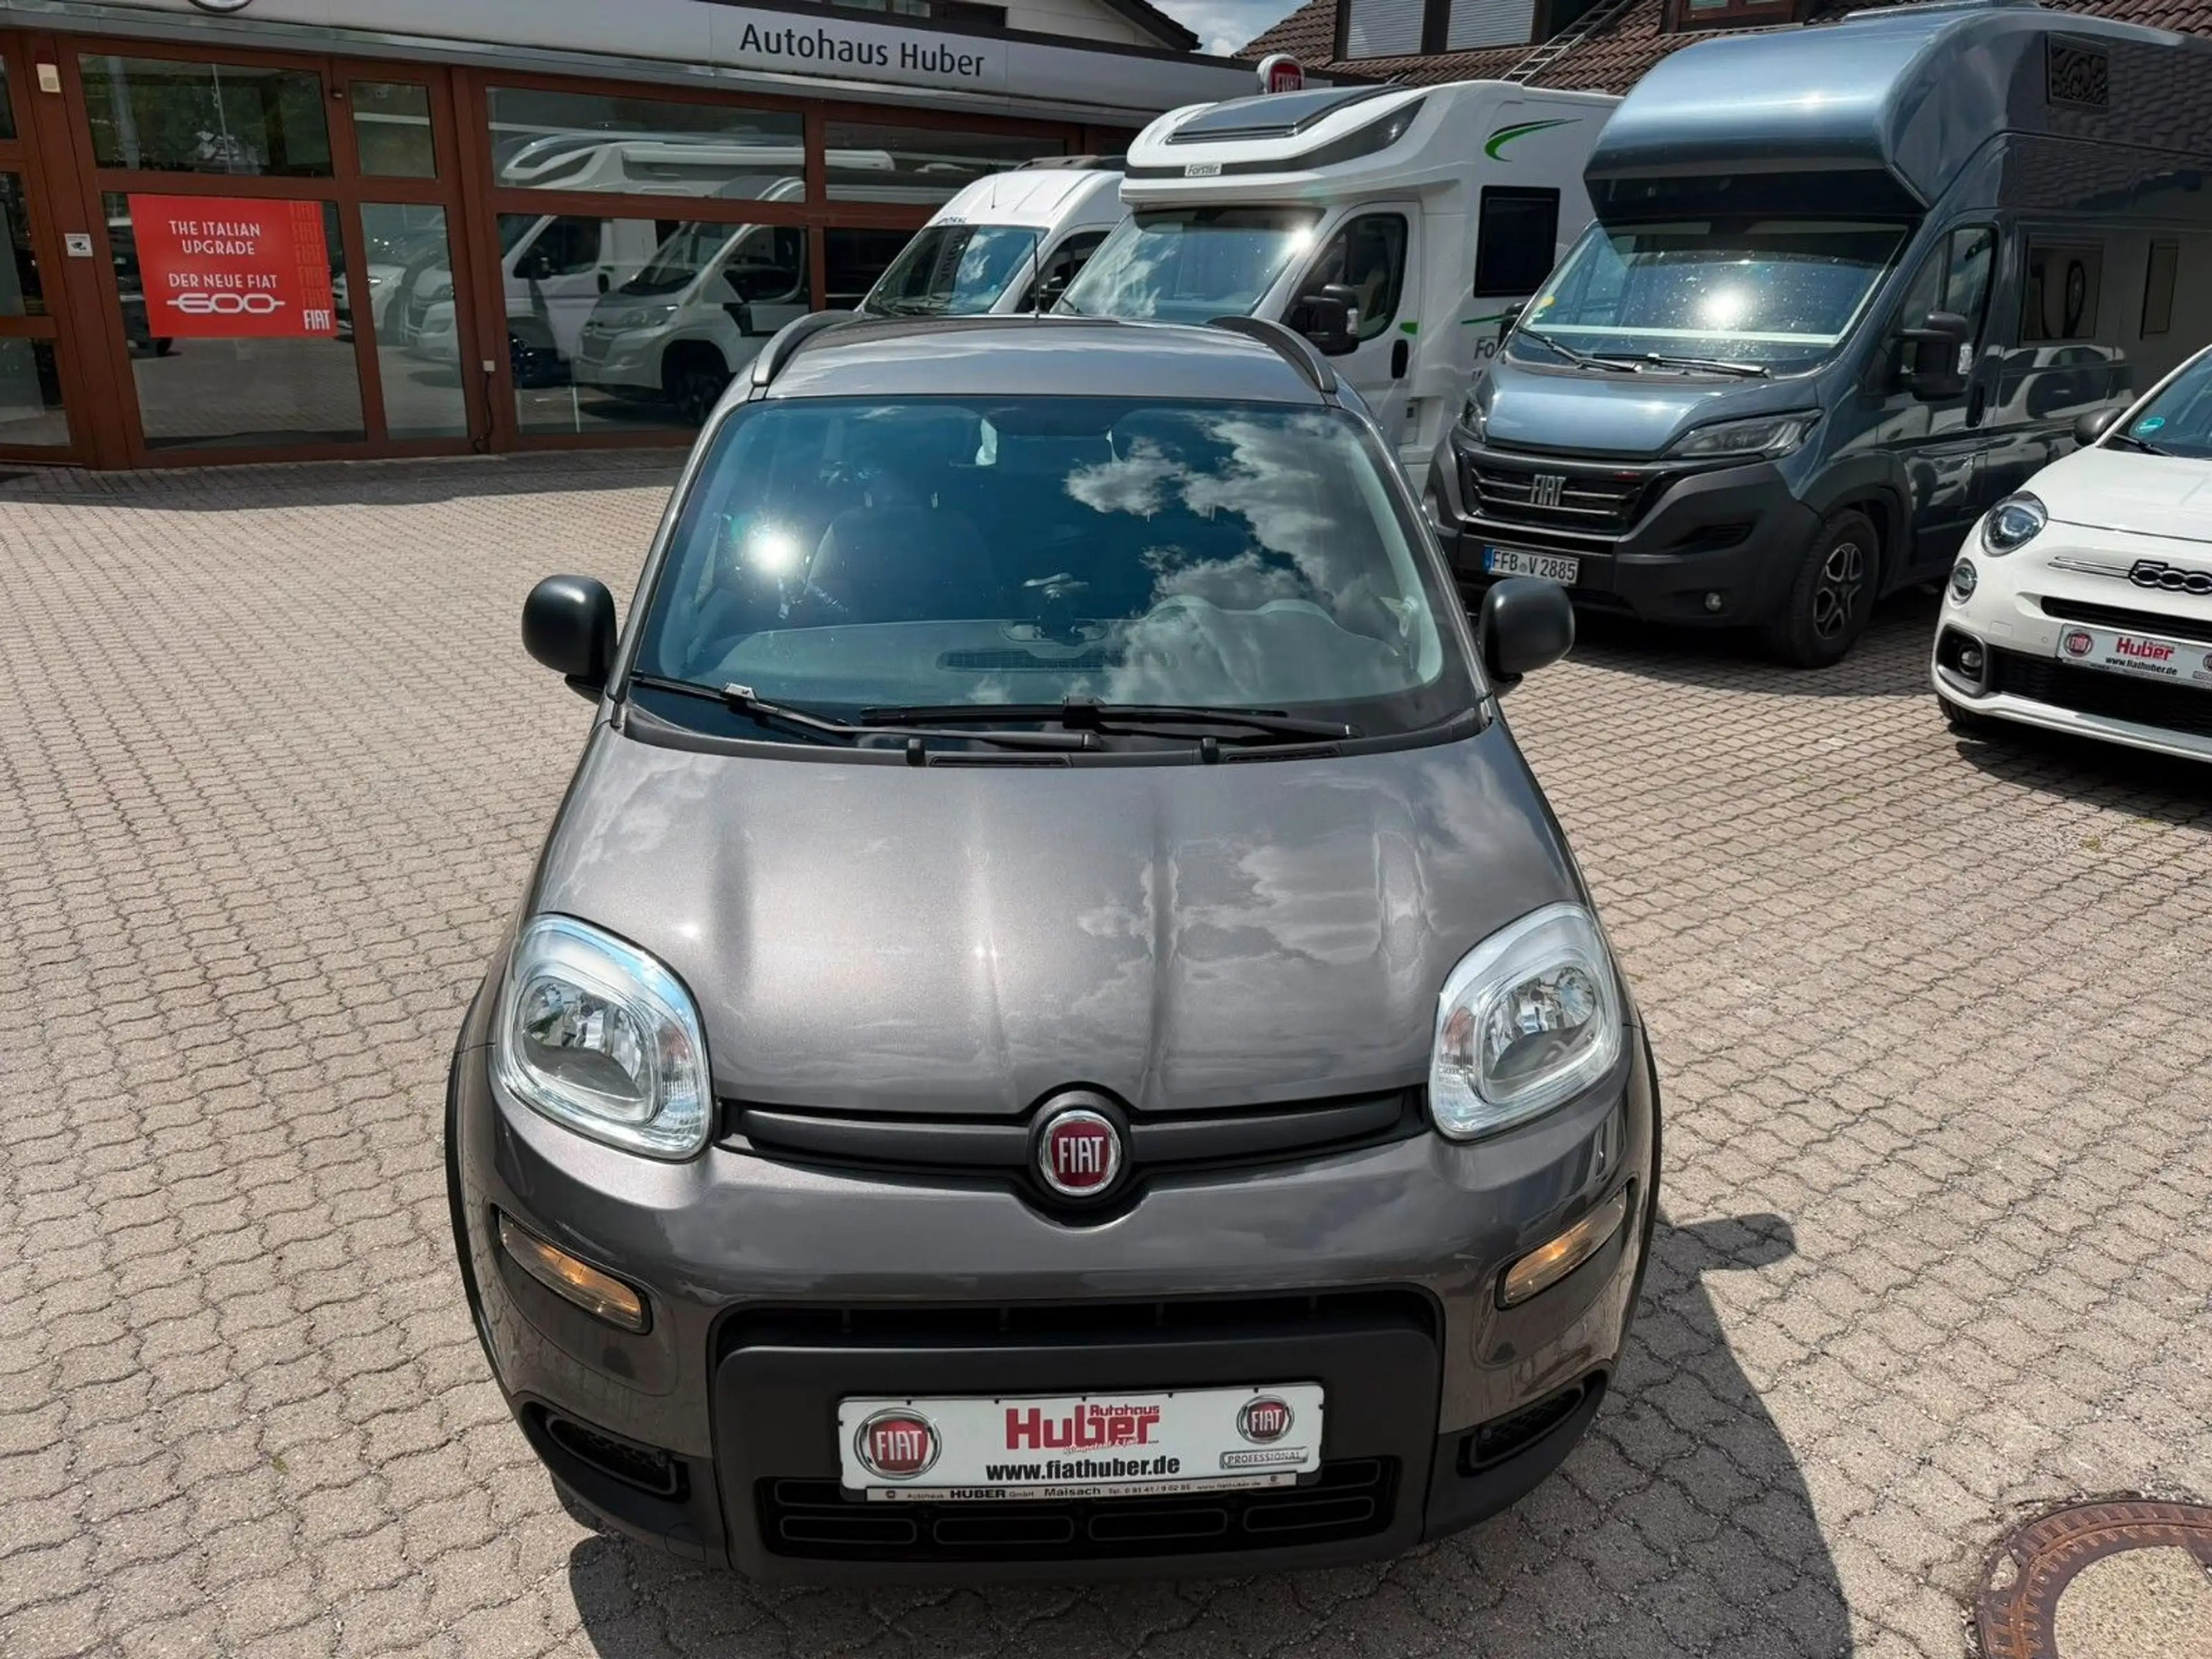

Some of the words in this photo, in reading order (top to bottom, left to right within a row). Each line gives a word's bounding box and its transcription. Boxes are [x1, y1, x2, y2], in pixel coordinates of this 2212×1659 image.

[740, 23, 888, 66] Autohaus
[900, 42, 985, 77] Huber
[168, 220, 198, 235] THE
[202, 221, 261, 237] ITALIAN
[181, 239, 255, 255] UPGRADE
[168, 273, 199, 287] DER
[203, 274, 243, 288] NEUE
[247, 275, 277, 289] FIAT
[303, 309, 330, 330] FIAT
[1530, 474, 1566, 506] FIAT
[1493, 551, 1518, 571] FFB
[1529, 556, 1538, 574] V
[1540, 559, 1576, 581] 2885
[2116, 636, 2174, 661] Huber
[1058, 1136, 1104, 1173] FIAT
[1090, 1404, 1160, 1416] Autohaus
[1251, 1409, 1282, 1431] FIAT
[1006, 1404, 1160, 1450] Huber
[876, 1430, 922, 1461] FIAT
[986, 1456, 1180, 1480] www.fiathuber.de
[1227, 1452, 1302, 1464] PROFESSIONAL
[950, 1490, 1006, 1499] HUBER
[1044, 1487, 1100, 1497] Maisach
